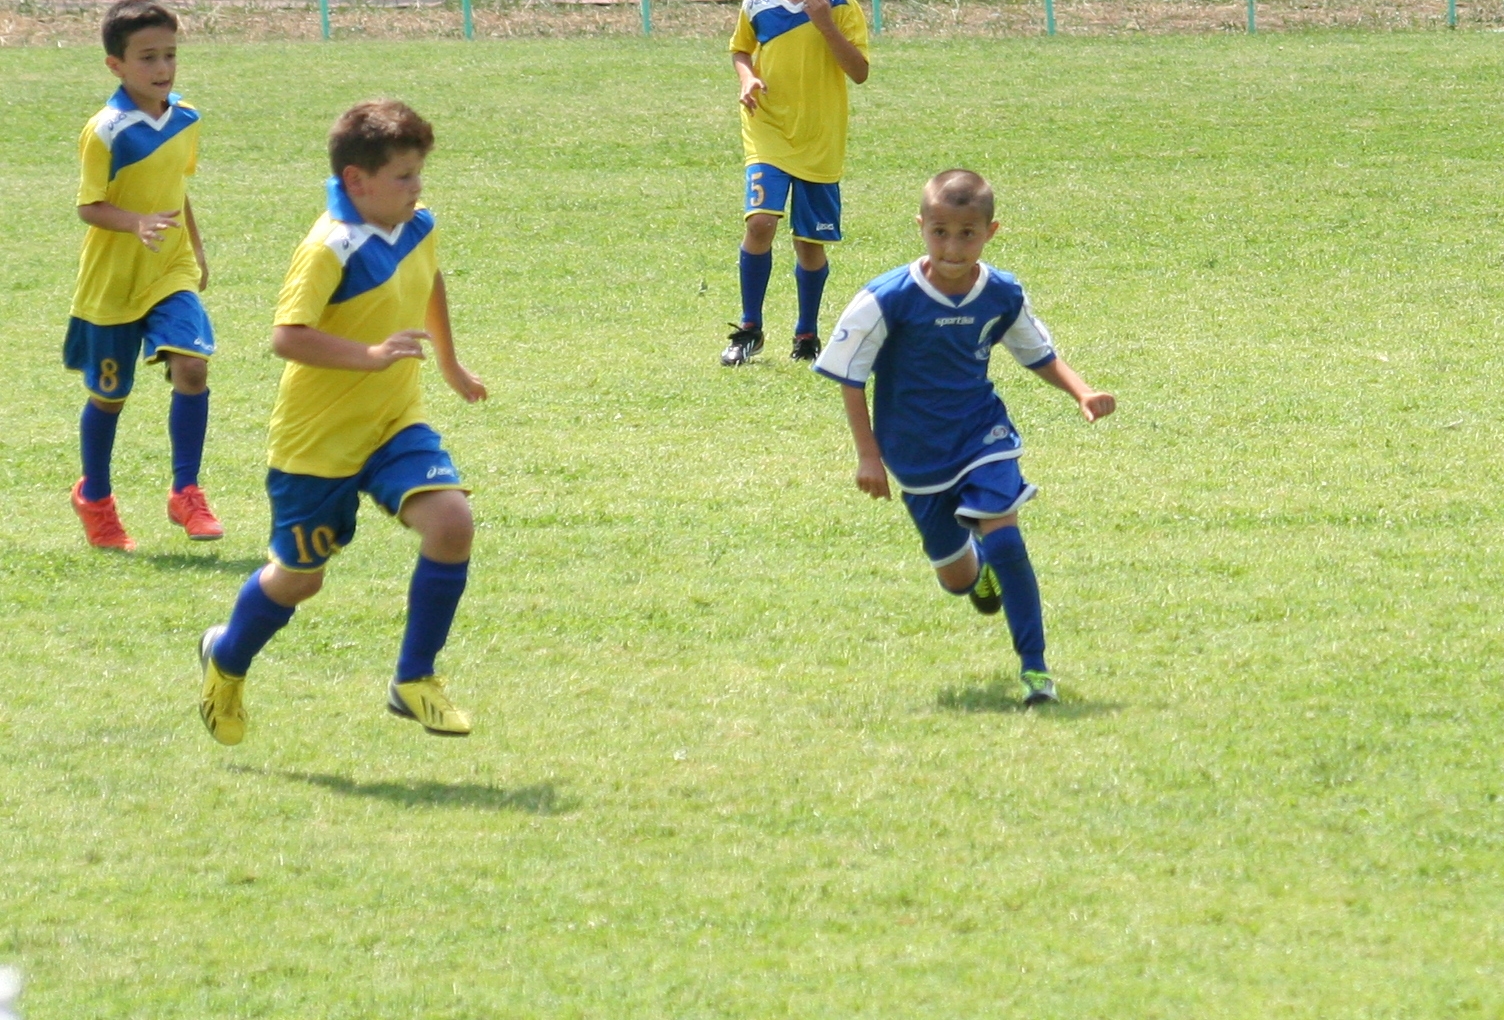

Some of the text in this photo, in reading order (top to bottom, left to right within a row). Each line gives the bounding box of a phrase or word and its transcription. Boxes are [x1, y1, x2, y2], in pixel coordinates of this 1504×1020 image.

[750, 172, 764, 207] 5
[100, 358, 118, 393] 8
[292, 524, 335, 563] 10
